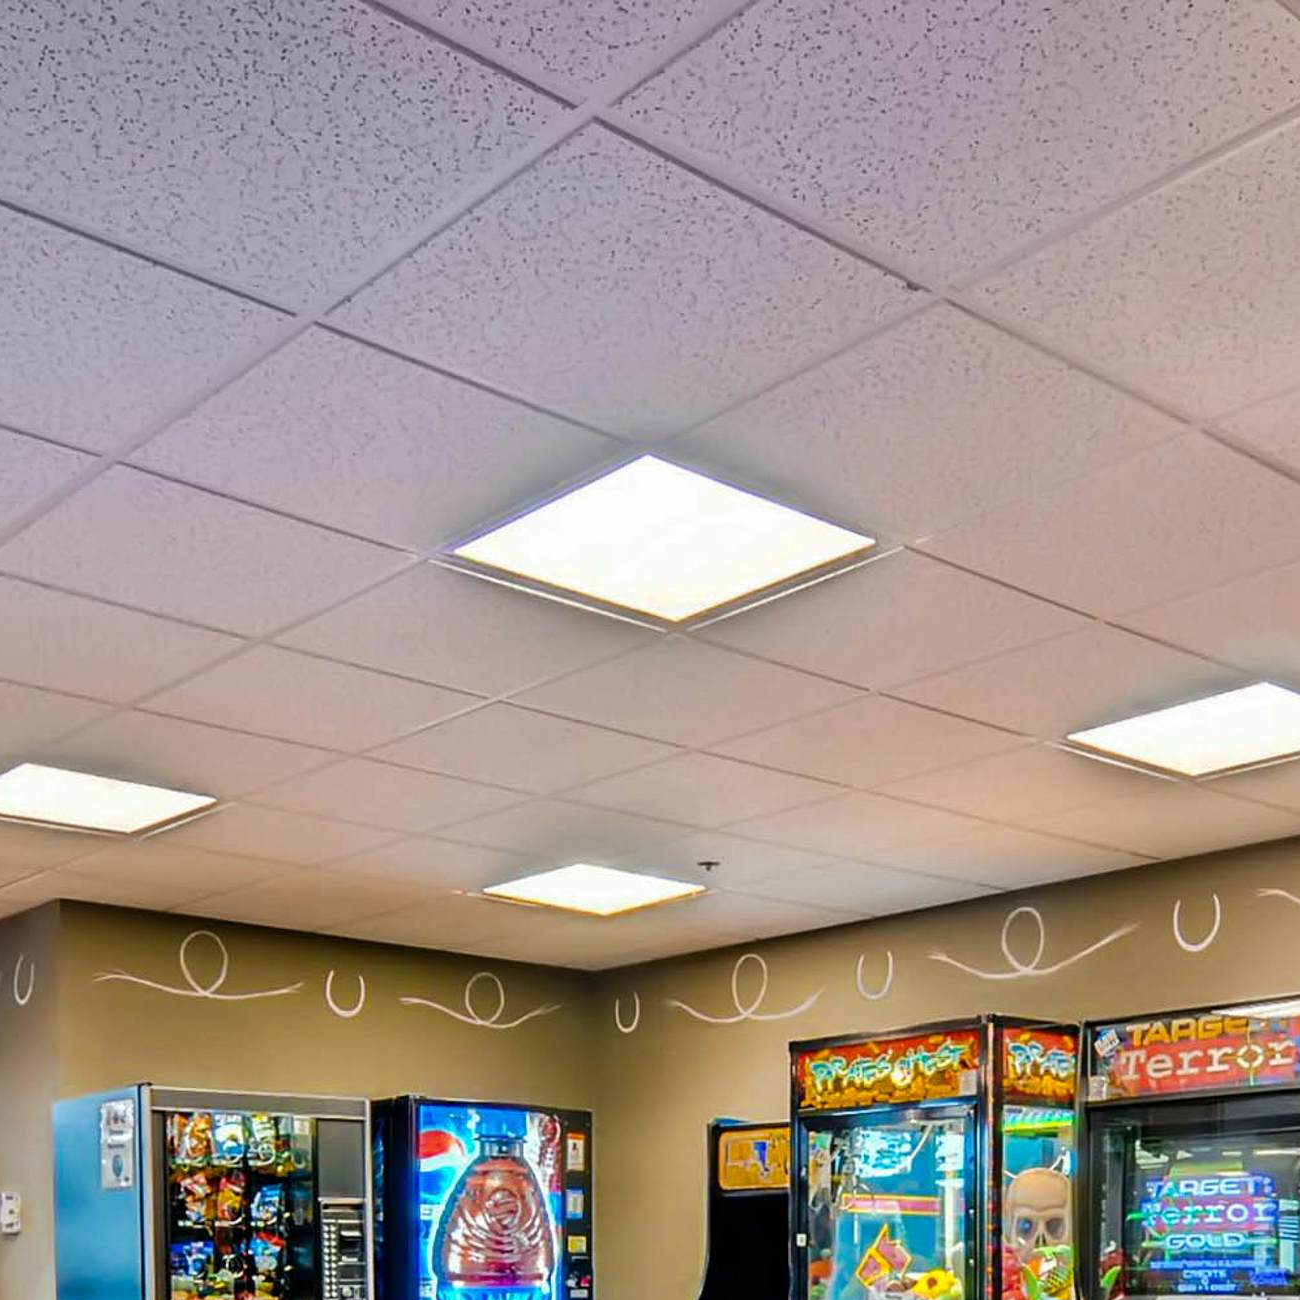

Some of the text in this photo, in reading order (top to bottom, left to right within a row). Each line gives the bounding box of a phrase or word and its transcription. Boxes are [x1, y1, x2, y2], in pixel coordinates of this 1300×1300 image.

[1126, 1016, 1292, 1047] TARGE
[1121, 1039, 1296, 1081] Terror
[1165, 1233, 1246, 1249] GOLD
